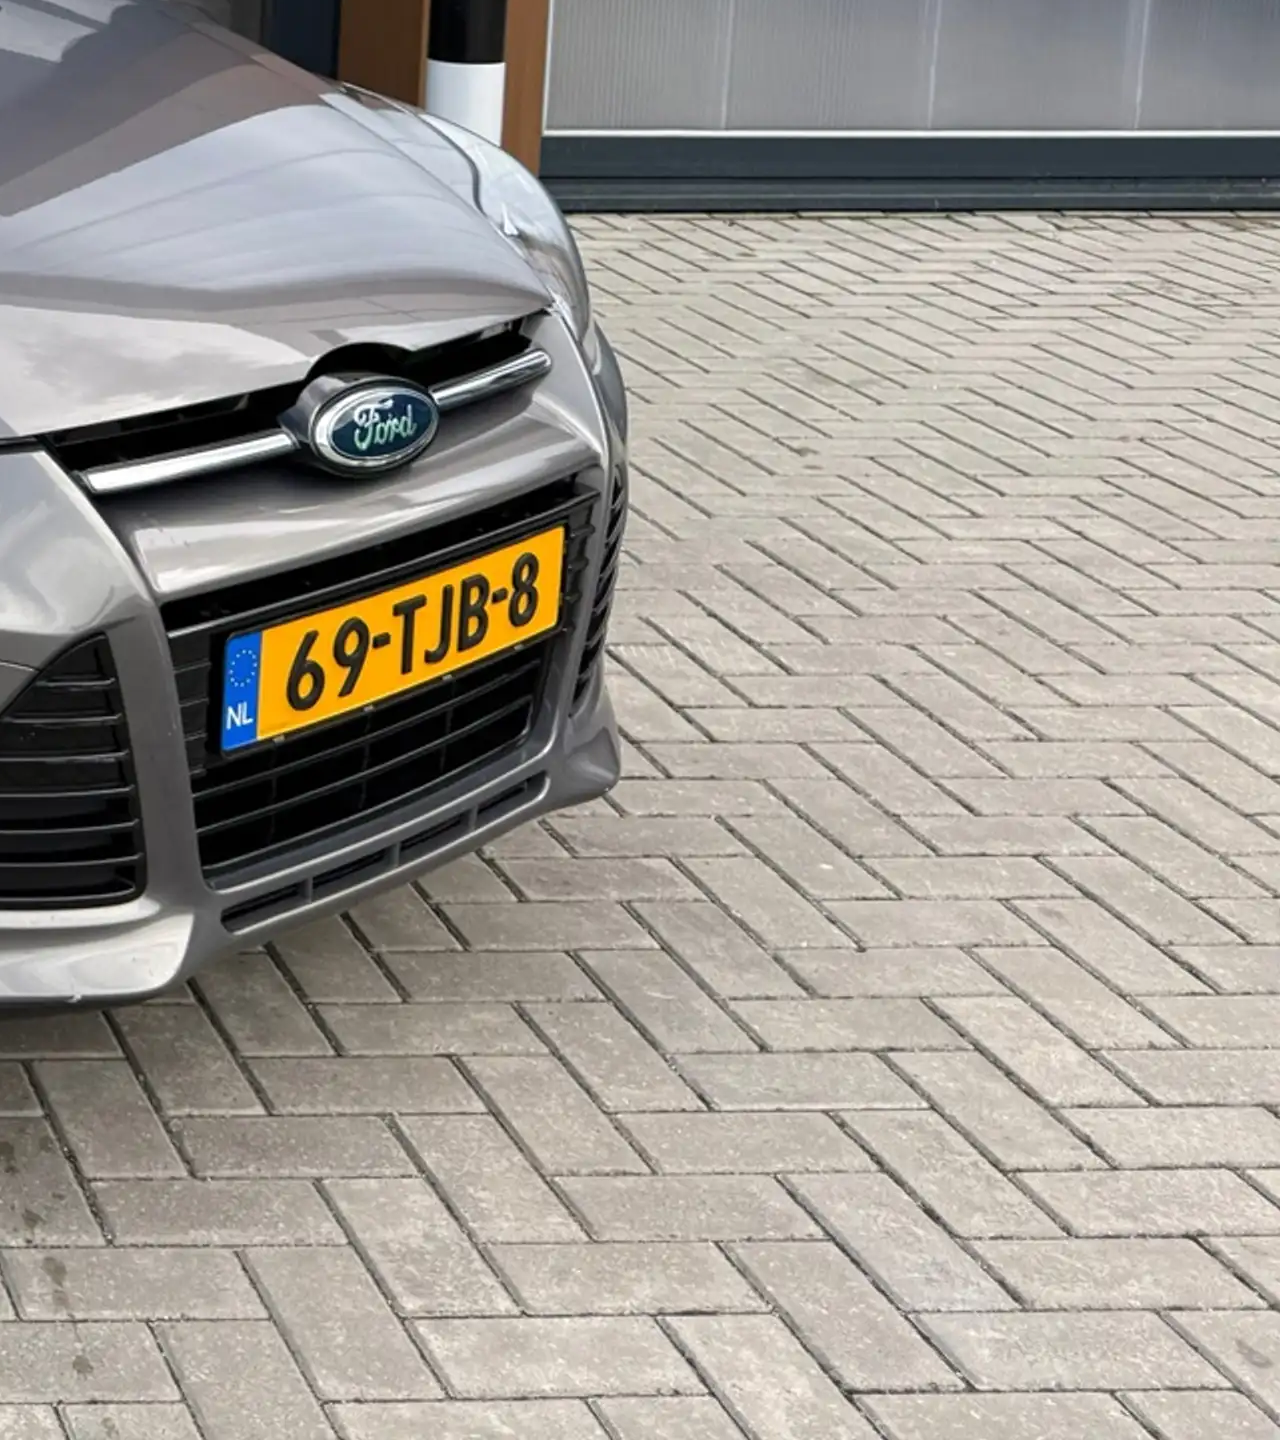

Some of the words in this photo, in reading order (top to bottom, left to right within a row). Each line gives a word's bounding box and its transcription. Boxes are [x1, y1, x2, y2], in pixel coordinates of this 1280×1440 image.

[351, 396, 419, 450] Ford
[285, 550, 539, 713] 69-TJB-8
[226, 703, 254, 730] NL
